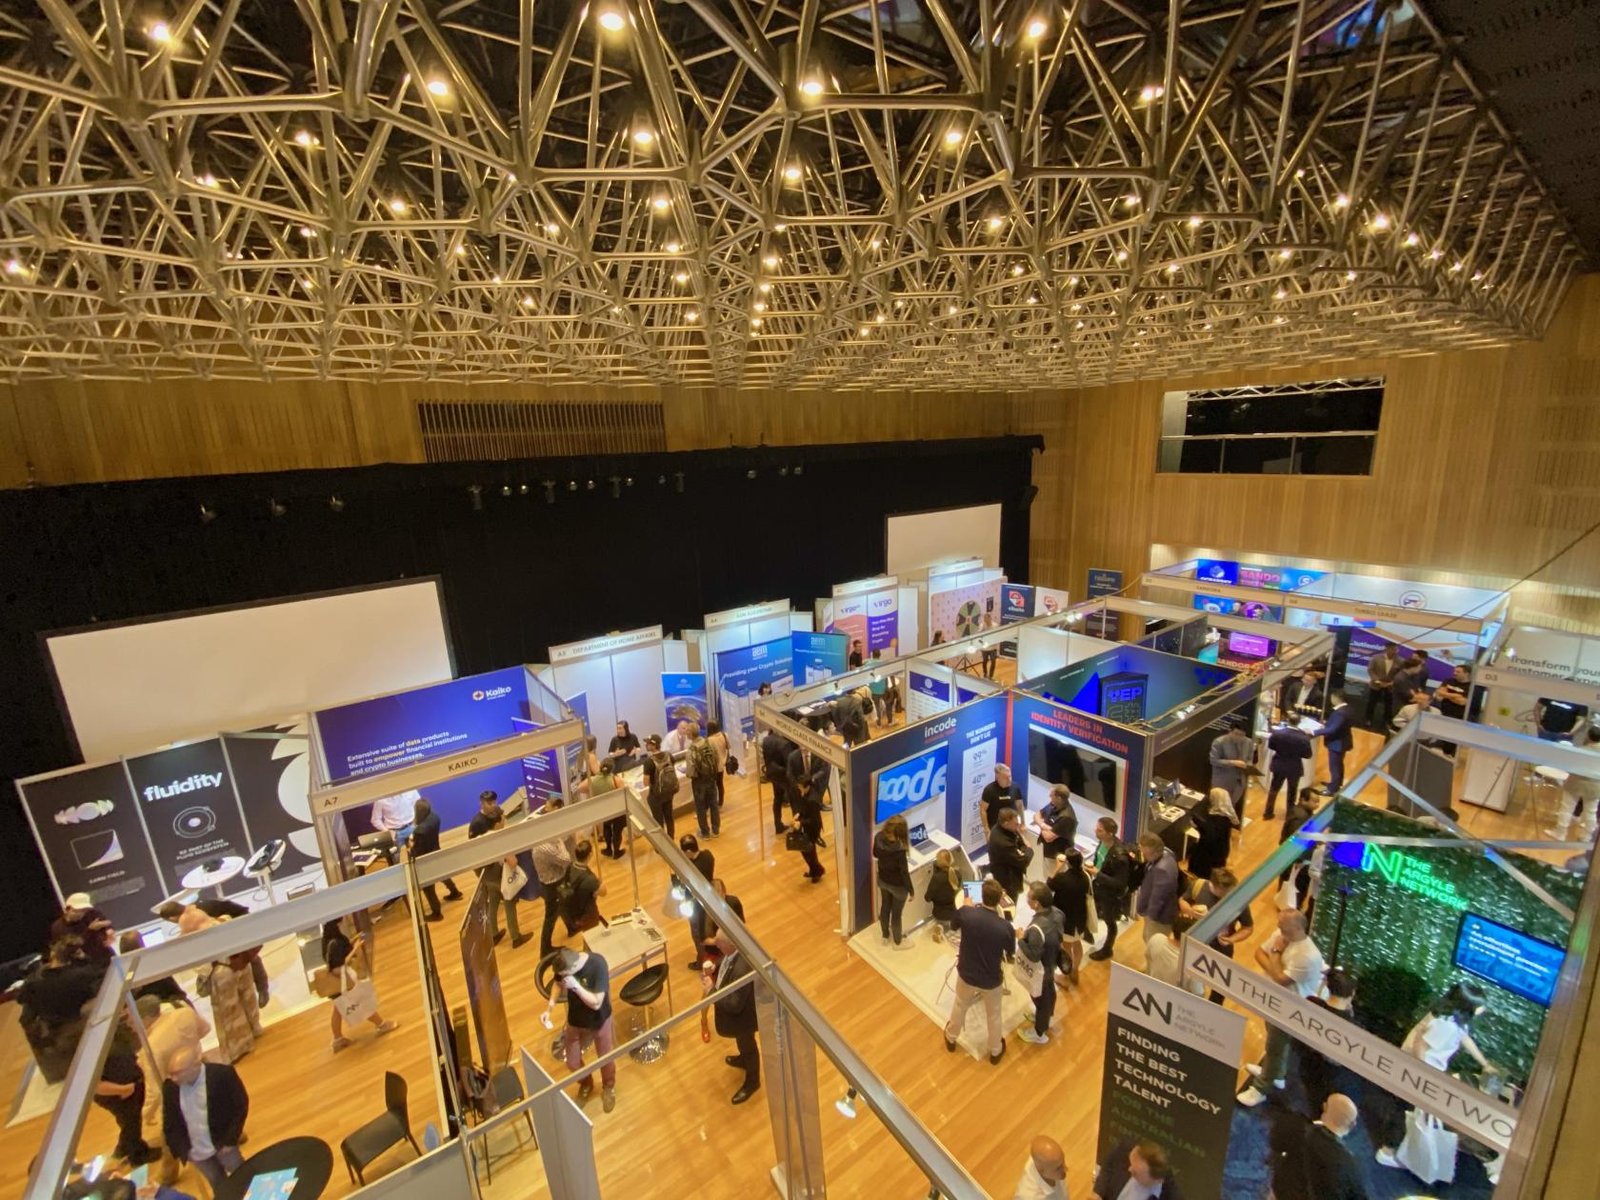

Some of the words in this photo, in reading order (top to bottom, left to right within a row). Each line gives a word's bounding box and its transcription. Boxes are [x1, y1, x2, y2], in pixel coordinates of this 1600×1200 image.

[486, 686, 512, 697] Kaiko
[924, 716, 957, 738] incode
[1031, 712, 1067, 730] IDENTITY
[1068, 722, 1128, 754] VERIFICATION
[1053, 710, 1091, 729] LEADERS
[1093, 722, 1103, 734] IN
[347, 748, 380, 762] Extensive
[381, 744, 397, 754] suite
[406, 739, 421, 747] data
[422, 731, 449, 744] products
[349, 760, 364, 769] built
[374, 750, 405, 763] empower
[406, 740, 433, 754] financial
[434, 733, 468, 746] institutions
[350, 768, 364, 776] and
[365, 762, 386, 774] crypto
[448, 757, 478, 772] KAIKO
[144, 772, 222, 802] fluidity
[324, 796, 338, 808] A7
[1404, 855, 1432, 874] THE
[1400, 878, 1469, 911] NETWORK
[1402, 868, 1455, 894] ARGYLE
[1238, 976, 1282, 1014] THE
[1289, 1010, 1394, 1076] ARGYLE
[1117, 1026, 1181, 1063] FINDING
[1116, 1042, 1145, 1064] THE
[1148, 1058, 1188, 1083] BEST
[1113, 1074, 1172, 1109] TALENT
[1114, 1058, 1222, 1116] TECHNOLOGY
[1111, 1106, 1206, 1158] AUSTRALIAN
